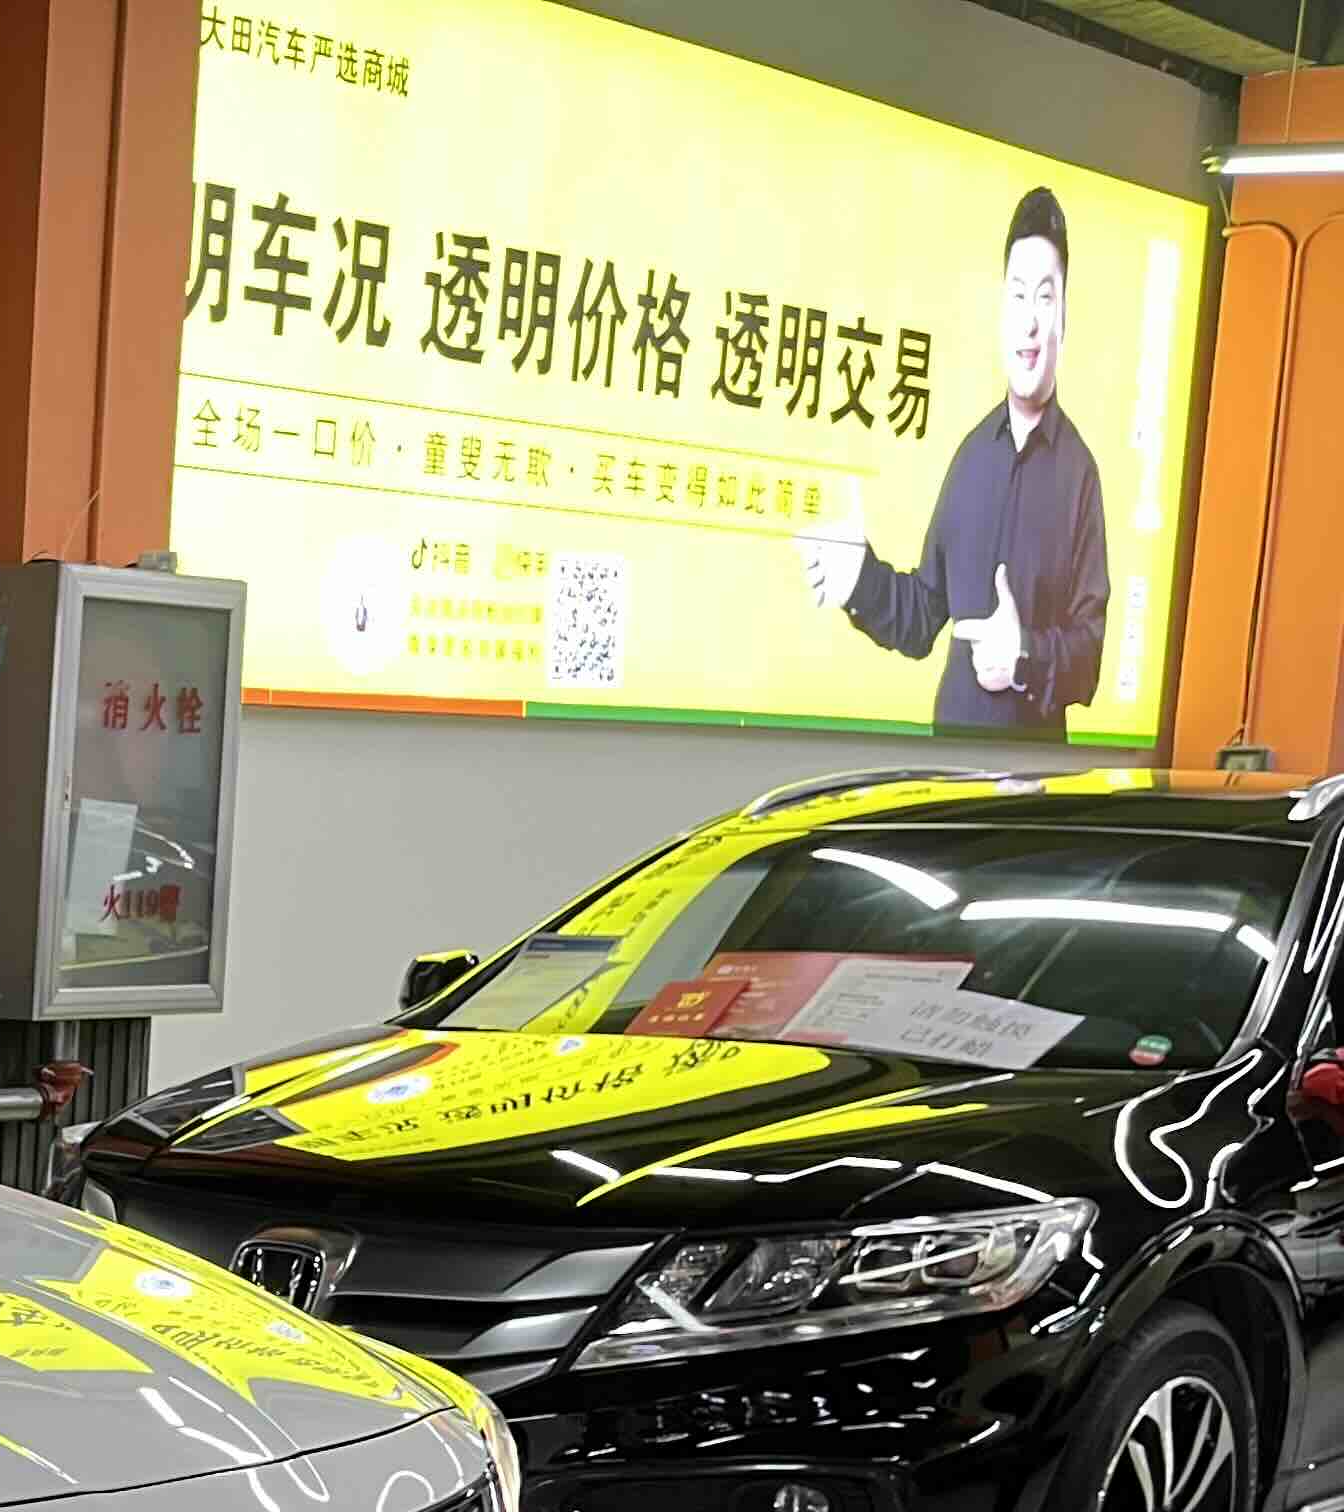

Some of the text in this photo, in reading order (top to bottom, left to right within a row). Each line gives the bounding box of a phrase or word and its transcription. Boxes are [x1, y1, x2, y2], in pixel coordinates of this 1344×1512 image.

[199, 5, 410, 98] 大田汽车严选商城
[420, 231, 691, 399] 透明价格
[712, 291, 932, 440] 透明交易
[102, 679, 204, 735] 消火栓
